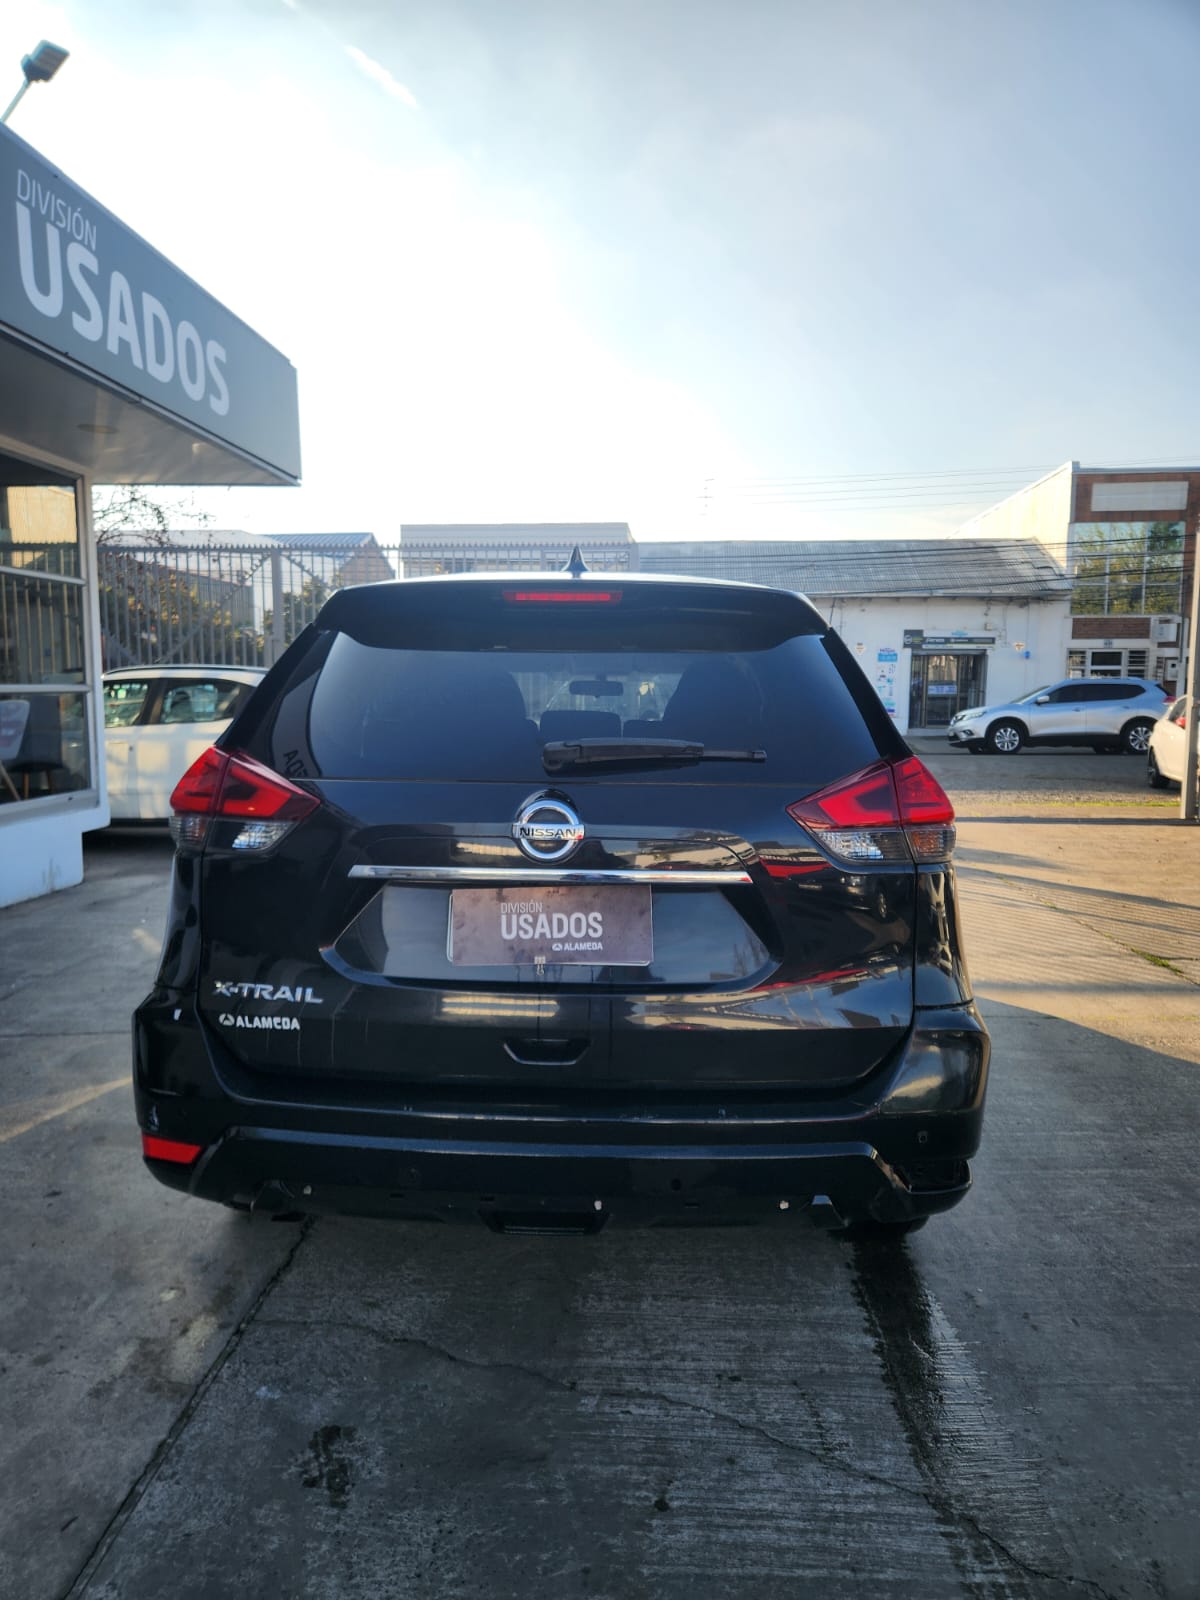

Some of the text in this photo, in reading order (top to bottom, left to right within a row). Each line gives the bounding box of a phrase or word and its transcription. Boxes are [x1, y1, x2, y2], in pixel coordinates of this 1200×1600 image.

[17, 169, 96, 250] DIVISIÓN
[16, 201, 229, 416] USADOS
[519, 826, 576, 838] NISSAN
[501, 899, 543, 913] DIVISIÓN
[501, 912, 603, 940] USADOS
[563, 942, 603, 951] ALAMEDA
[213, 982, 323, 1004] X-TRAIL
[236, 1015, 300, 1030] ALAMEDA
